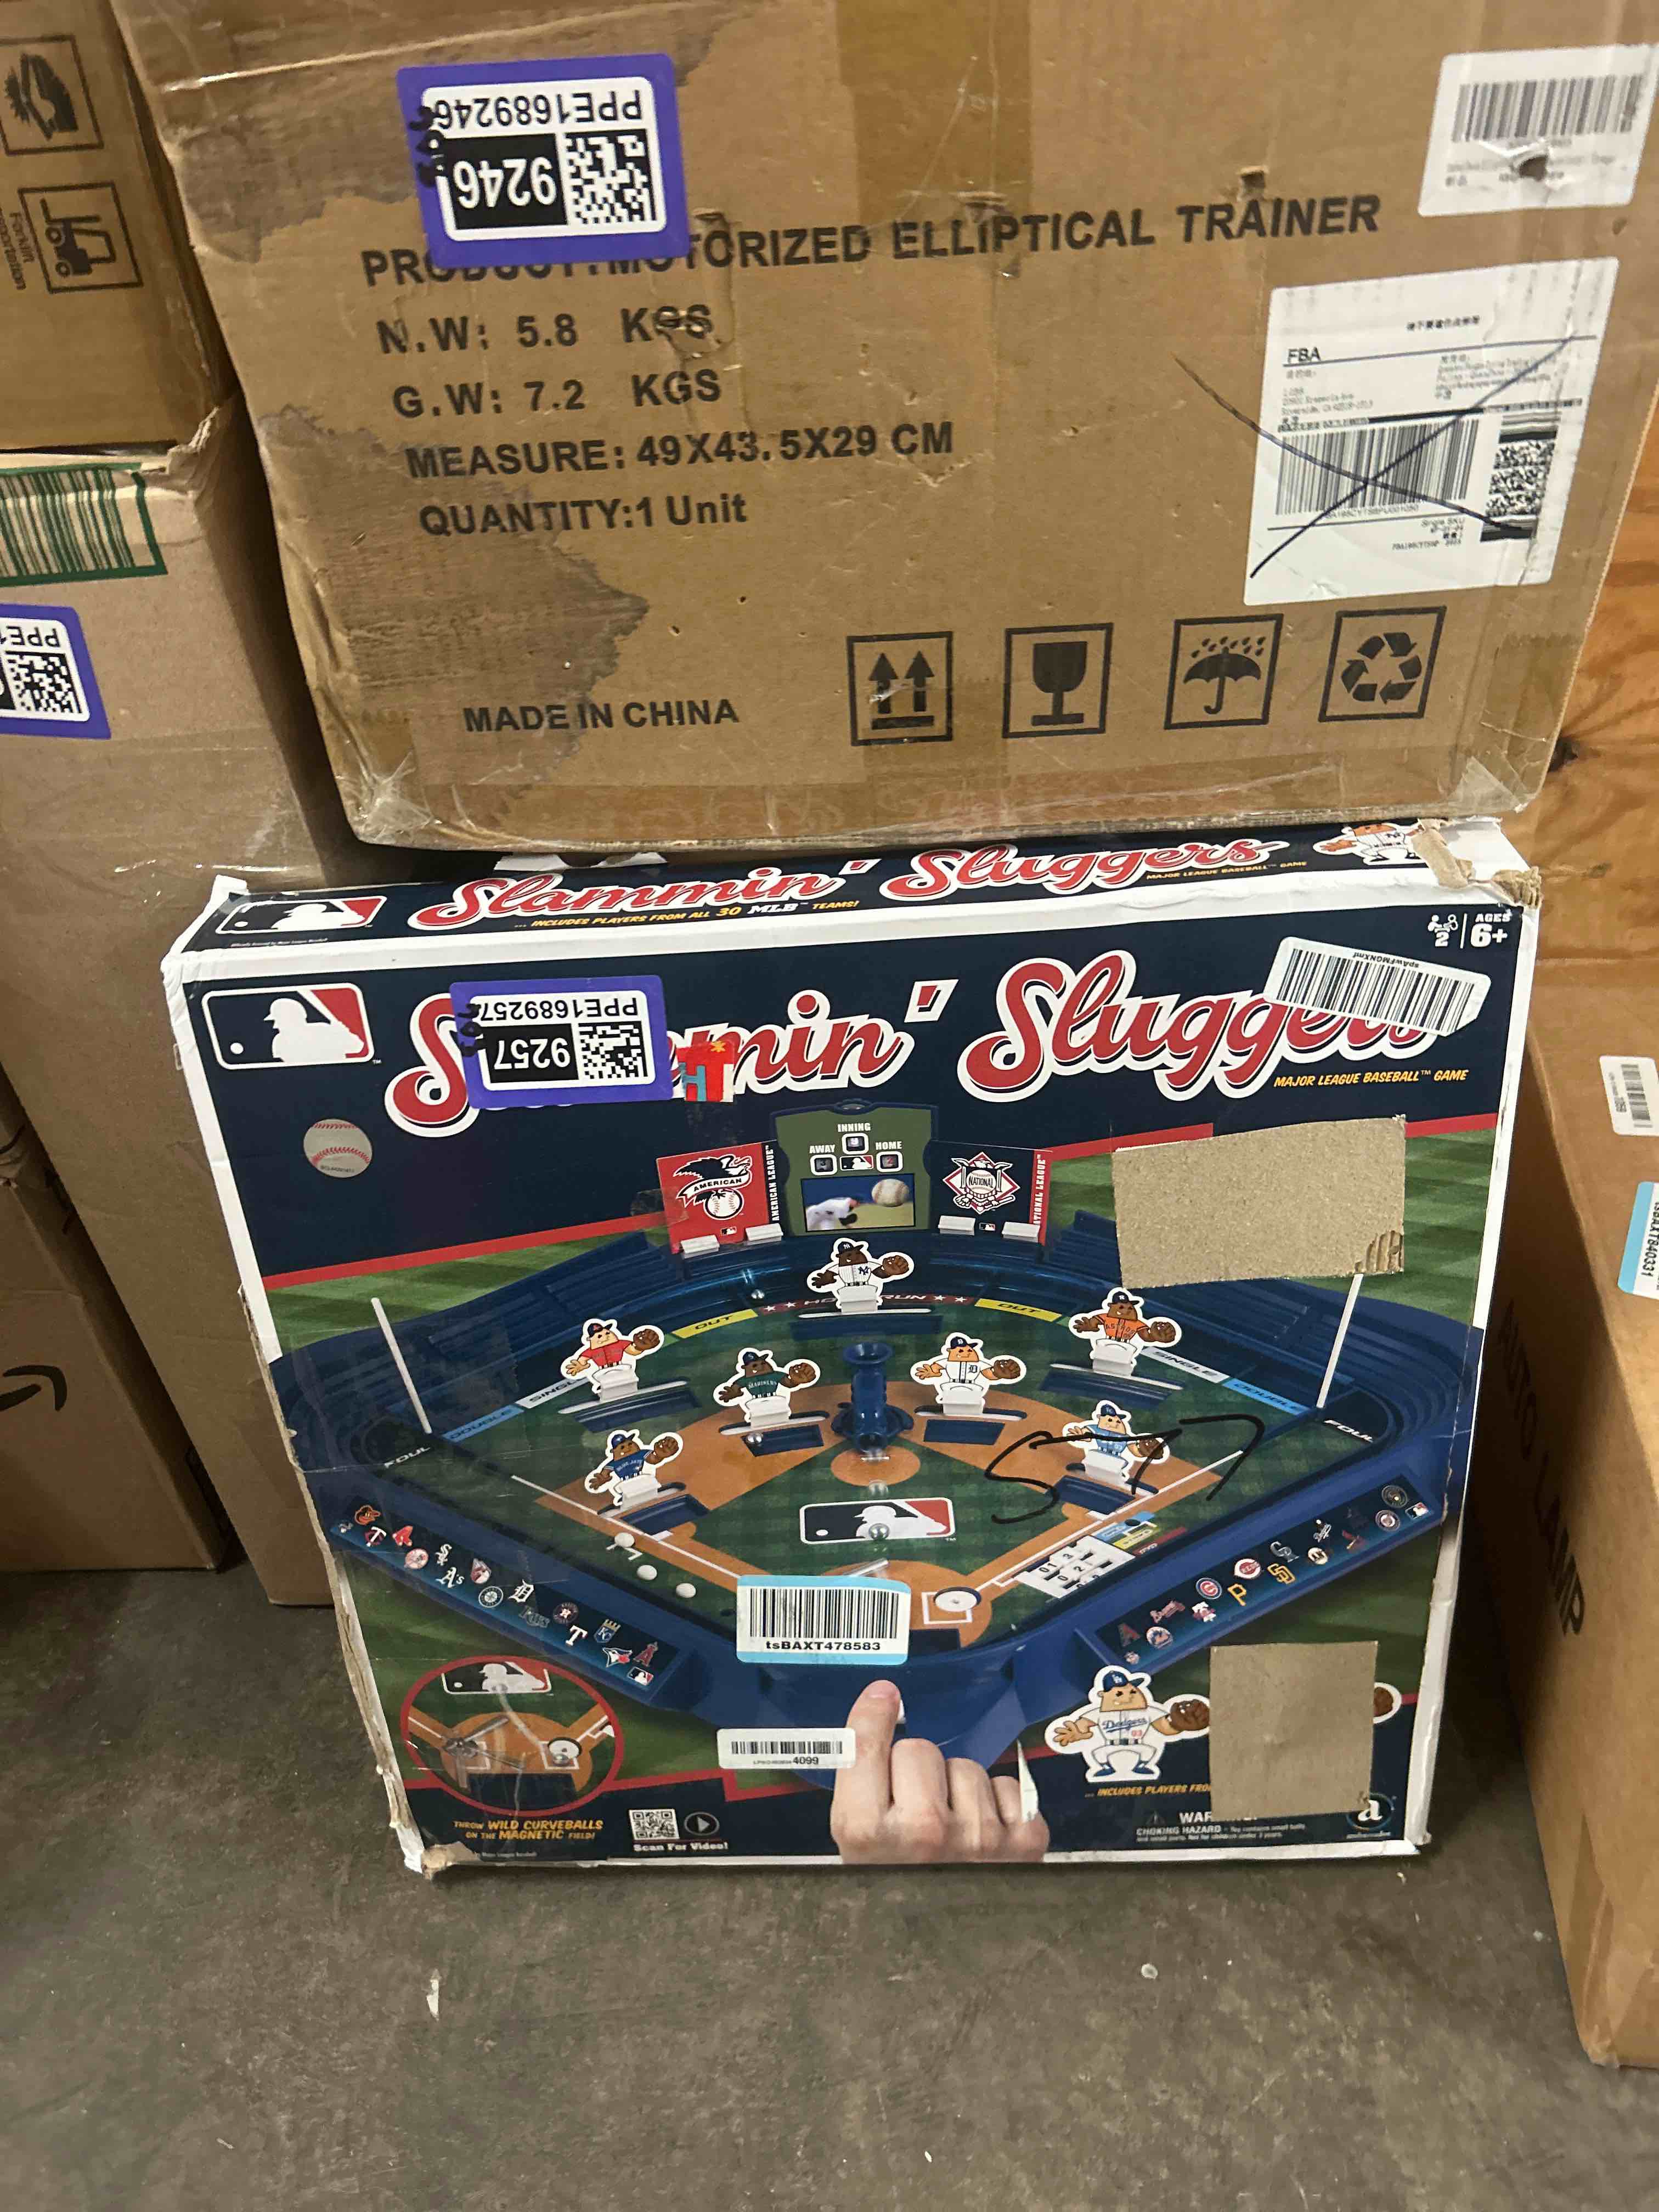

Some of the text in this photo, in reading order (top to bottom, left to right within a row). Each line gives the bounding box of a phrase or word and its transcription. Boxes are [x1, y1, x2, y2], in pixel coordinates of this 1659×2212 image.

[433, 89, 642, 130] PPE1689246
[453, 156, 558, 209] 9246
[893, 207, 1155, 261] ELLIPTICAL
[1176, 194, 1381, 243] TRAINER
[376, 304, 713, 355] N.W: 5.8 KGS
[1287, 347, 1322, 363] FBA
[393, 368, 721, 418] G.W: 7.2 KGS
[405, 439, 625, 479] MEASURE:
[891, 421, 953, 456] CM
[419, 493, 748, 537] QUANTITY:1 Unit
[463, 698, 740, 733] MADE IN CHINA
[408, 838, 1290, 931] Slammin' Sluggers
[1146, 872, 1181, 880] MAJOR
[531, 918, 590, 927] INCLUDES
[593, 916, 647, 926] PLAYERS
[649, 913, 687, 923] FROM
[688, 911, 712, 920] ALL
[715, 906, 741, 917] 30
[812, 901, 860, 910] TEAMS!
[1475, 912, 1513, 923] AGES
[1435, 923, 1508, 948] 2 6+
[479, 997, 639, 1023] PPE1689257
[493, 1037, 572, 1070] 9257
[1273, 1075, 1316, 1087] MAJOR
[1318, 1073, 1361, 1086] LEAGUE
[1434, 1069, 1470, 1082] GAME
[837, 1122, 871, 1133] INNING
[809, 1141, 902, 1154] AWAY HOME
[693, 1177, 743, 1192] AMERICAN
[968, 1175, 994, 1187] NATIONAL
[768, 1182, 780, 1221] AMERICAN
[1033, 1192, 1043, 1224] ATIONAL
[997, 1303, 1042, 1314] OUT
[695, 1315, 733, 1331] OUT
[528, 1377, 585, 1403] SINGL
[1324, 1420, 1374, 1443] FOUL
[383, 1446, 432, 1468] FOUL
[765, 1641, 881, 1651] tsBAXT478583
[1102, 1718, 1148, 1733] Dodgers
[793, 1756, 819, 1765] 4099
[1097, 1786, 1142, 1797] INCLUDES
[1144, 1785, 1187, 1795] PLAYERS
[1189, 1783, 1211, 1793] FRO
[465, 1831, 479, 1839] ON
[499, 1830, 564, 1839] MAGNETIC
[567, 1832, 596, 1840] FIELD!
[488, 1820, 519, 1830] WILD
[523, 1820, 603, 1830] CURVEBALLS
[1136, 1826, 1180, 1836] CHOKING
[1182, 1824, 1221, 1834] HAZARD
[633, 1842, 729, 1852] Scan For Video!
